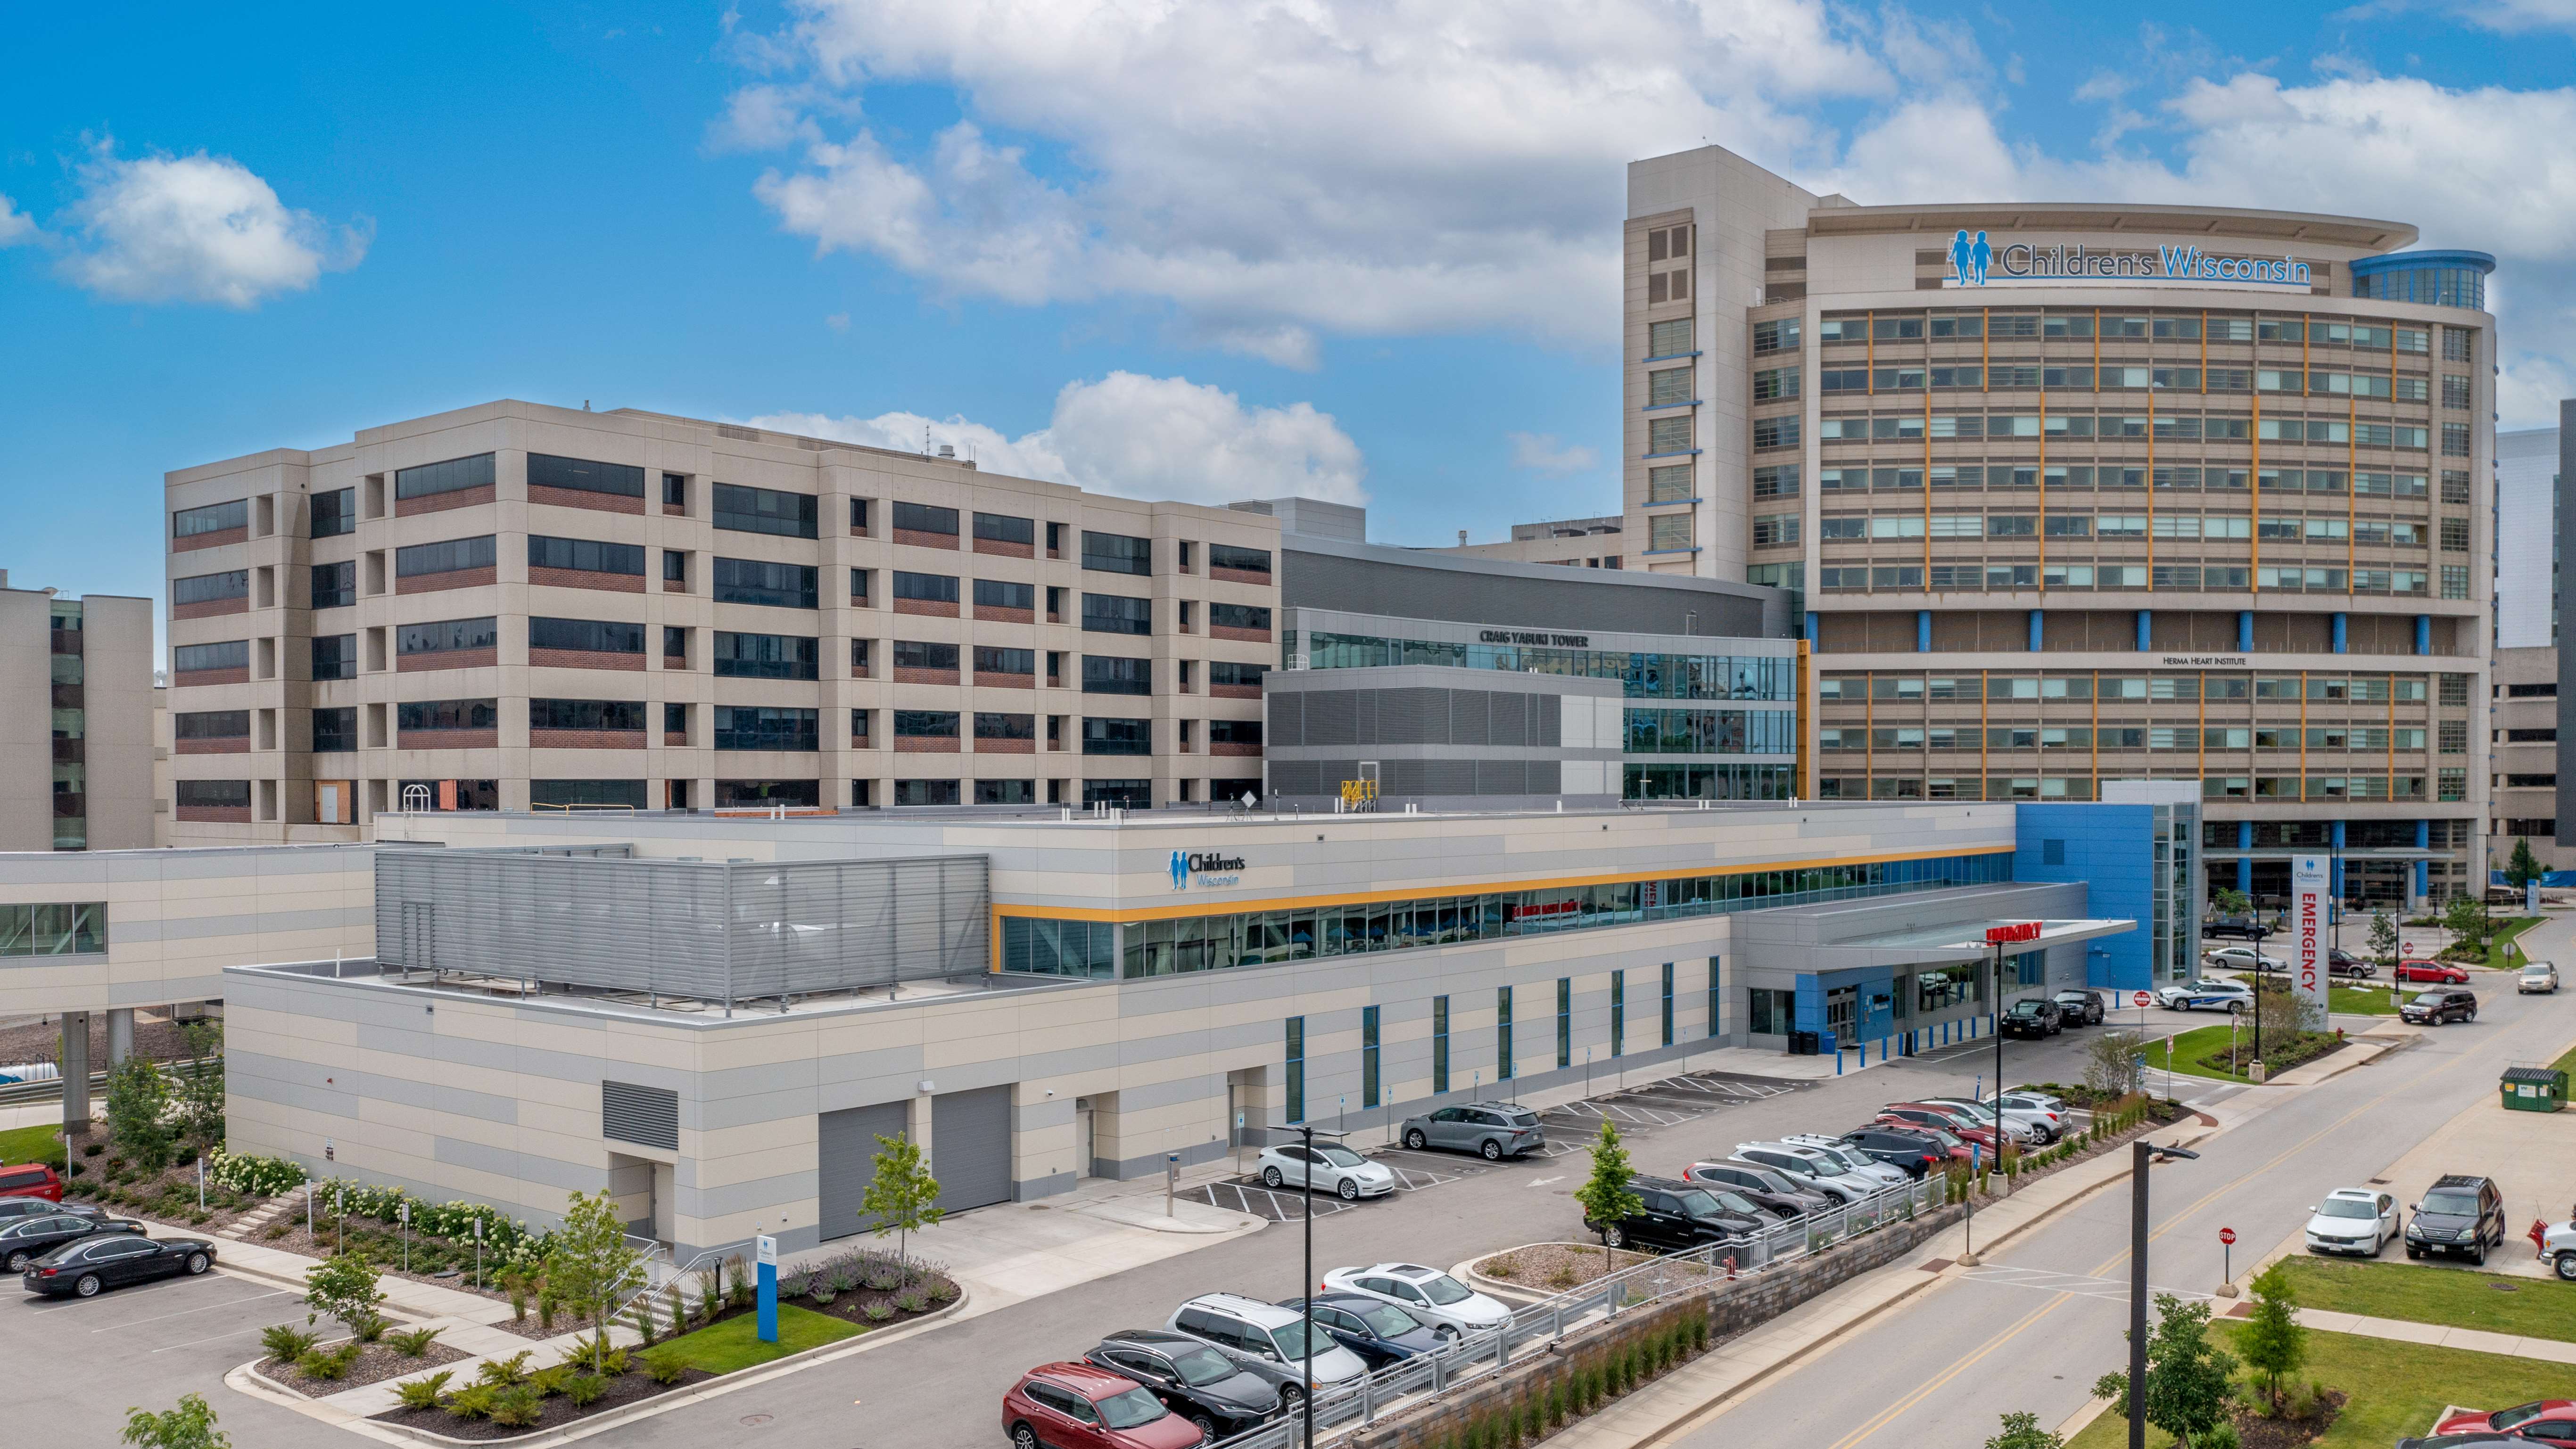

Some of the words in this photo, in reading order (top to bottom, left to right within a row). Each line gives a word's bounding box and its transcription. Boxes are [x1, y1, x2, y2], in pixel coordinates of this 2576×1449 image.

[2002, 243, 2153, 276] Children's
[2159, 244, 2310, 283] Wisconsin
[1480, 630, 1511, 642] CRAIG
[1511, 632, 1548, 645] YABUKI
[1551, 634, 1589, 647] TOWER
[2163, 657, 2188, 665] HERMA
[2215, 657, 2246, 665] INSTITUTE
[1188, 853, 1245, 872] Children's
[1197, 874, 1239, 887] Wisconsin
[1986, 922, 2042, 946] EMERGENCY
[2302, 893, 2316, 992] EMERGENCY
[2220, 1232, 2235, 1240] STOP
